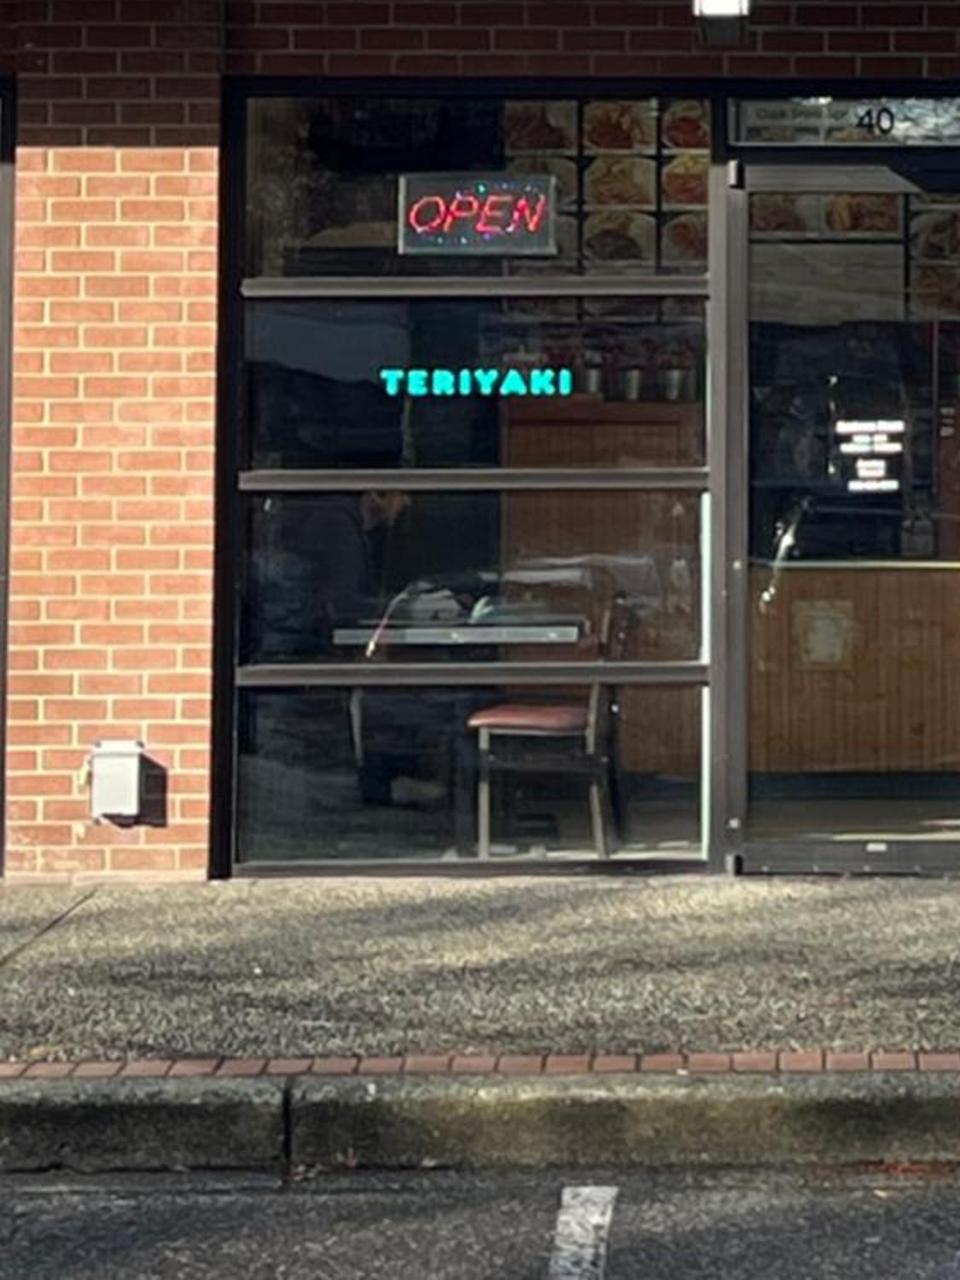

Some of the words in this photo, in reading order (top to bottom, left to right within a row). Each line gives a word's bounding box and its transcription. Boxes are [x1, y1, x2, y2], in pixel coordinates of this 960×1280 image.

[856, 107, 895, 134] 40
[409, 195, 547, 233] OPEN
[380, 368, 573, 396] TERIYAKI
